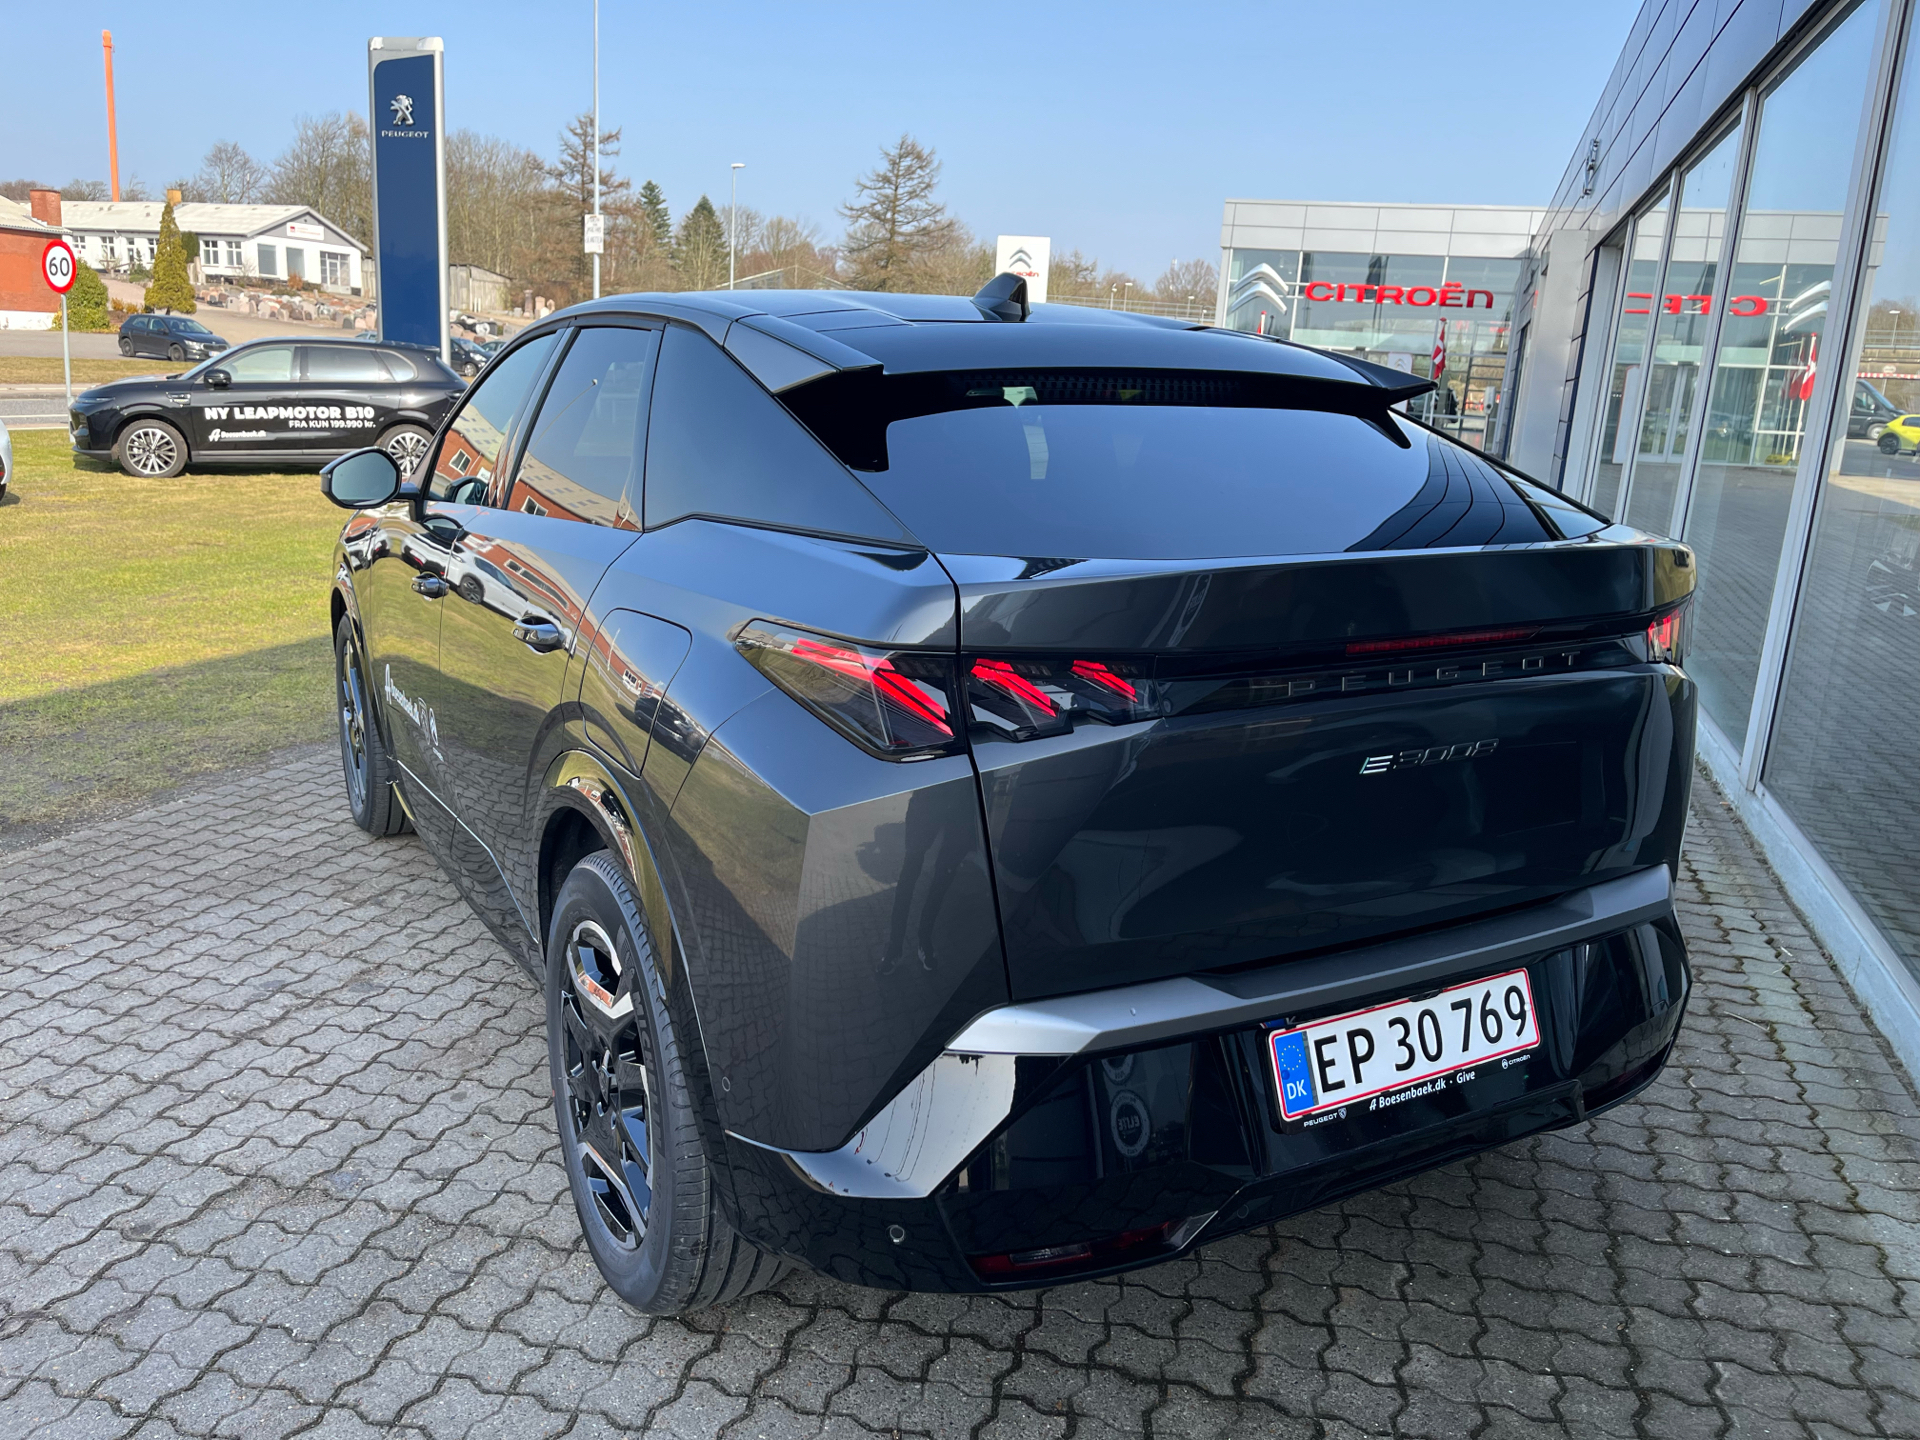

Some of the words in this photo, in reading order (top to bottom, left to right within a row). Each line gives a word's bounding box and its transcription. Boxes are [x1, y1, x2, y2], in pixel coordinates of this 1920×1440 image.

[381, 130, 430, 139] PEUGEOT
[49, 256, 70, 277] 60
[204, 407, 230, 421] NY
[234, 406, 342, 421] LEAPMOTOR
[345, 406, 376, 420] B10
[288, 420, 308, 429] FRA
[309, 420, 330, 429] KUN
[330, 420, 363, 429] 199.990
[364, 420, 377, 429] kr.
[1288, 651, 1581, 696] PEUGEOT
[1313, 1027, 1375, 1094] EP
[1388, 1008, 1444, 1072] 30
[1450, 985, 1527, 1053] 769
[631, 991, 662, 1152] MICHELIN
[1286, 1079, 1307, 1100] DK
[1379, 1077, 1447, 1109] Boesenbaek.dk
[1456, 1070, 1476, 1085] Give
[1303, 1112, 1338, 1128] PEUGEOT
